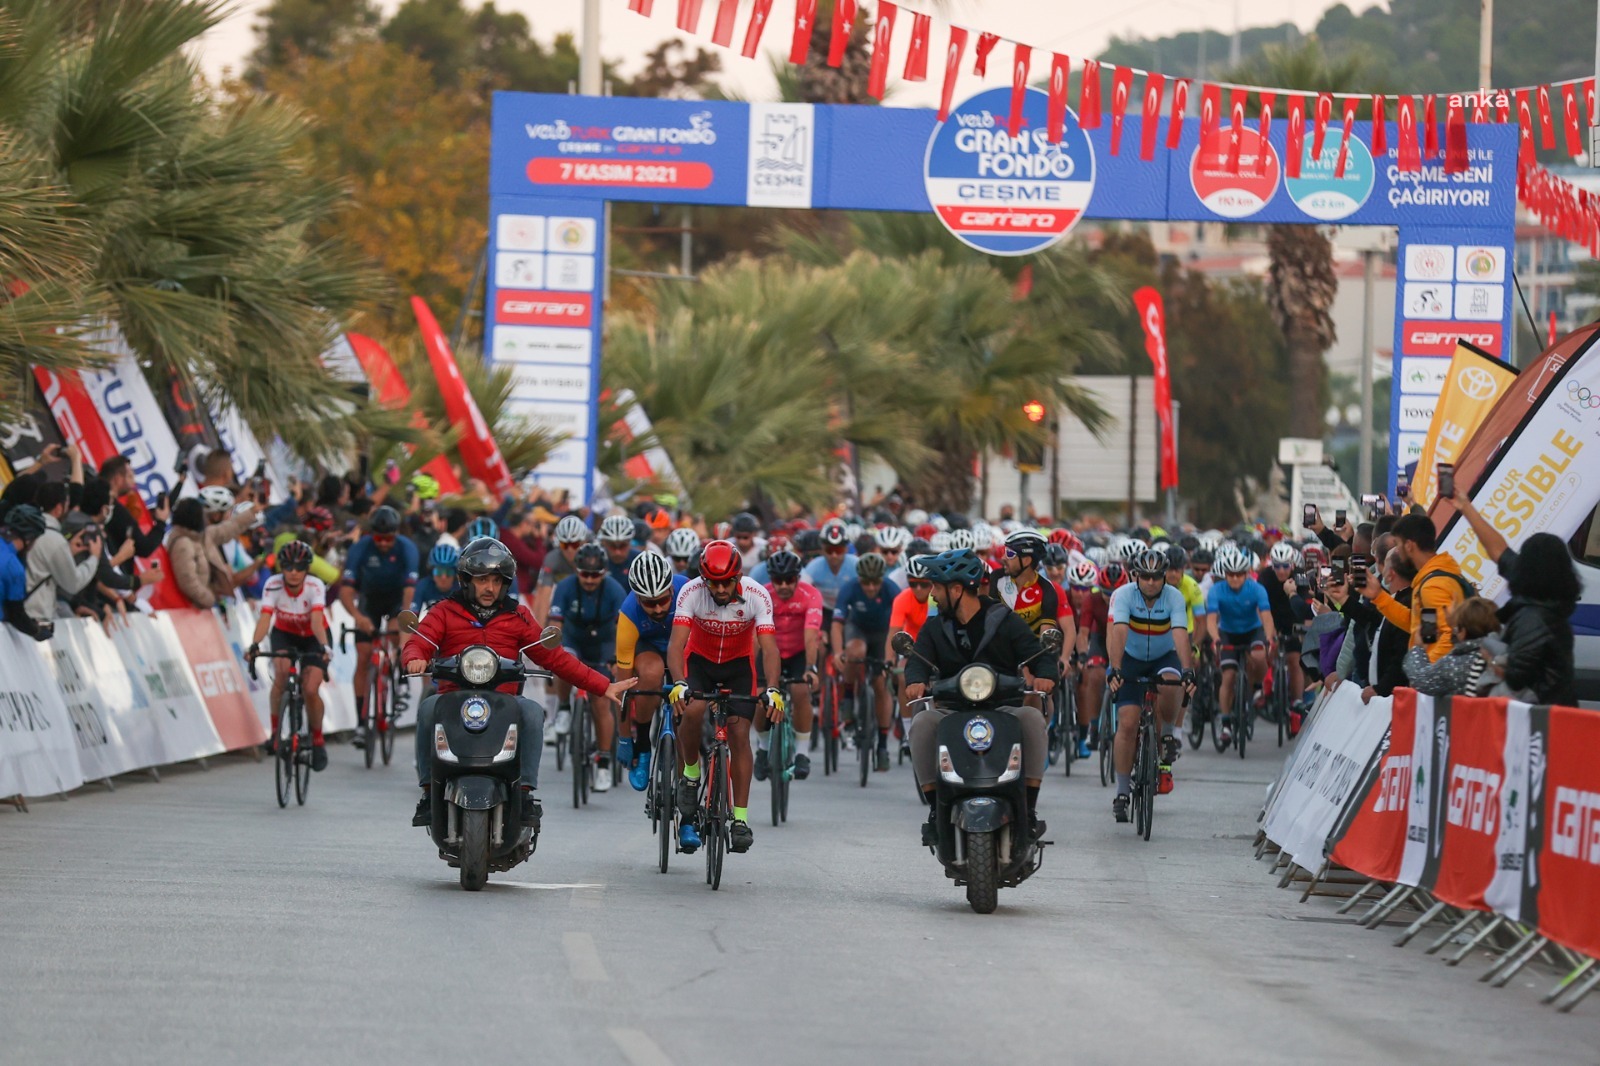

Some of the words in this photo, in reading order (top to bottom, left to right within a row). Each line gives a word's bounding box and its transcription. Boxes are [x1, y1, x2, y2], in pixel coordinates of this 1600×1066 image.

[612, 126, 658, 144] GRAN
[659, 127, 717, 146] FONDO
[955, 128, 1030, 154] GRAN
[559, 162, 573, 181] 7
[574, 163, 633, 182] KASIM
[635, 166, 678, 183] 2021
[978, 152, 1075, 179] FONDO
[1387, 185, 1491, 210] ÇAĞIRIYOR!
[960, 210, 1057, 228] carraro
[501, 300, 586, 317] carraro
[1484, 468, 1524, 510] YOUR
